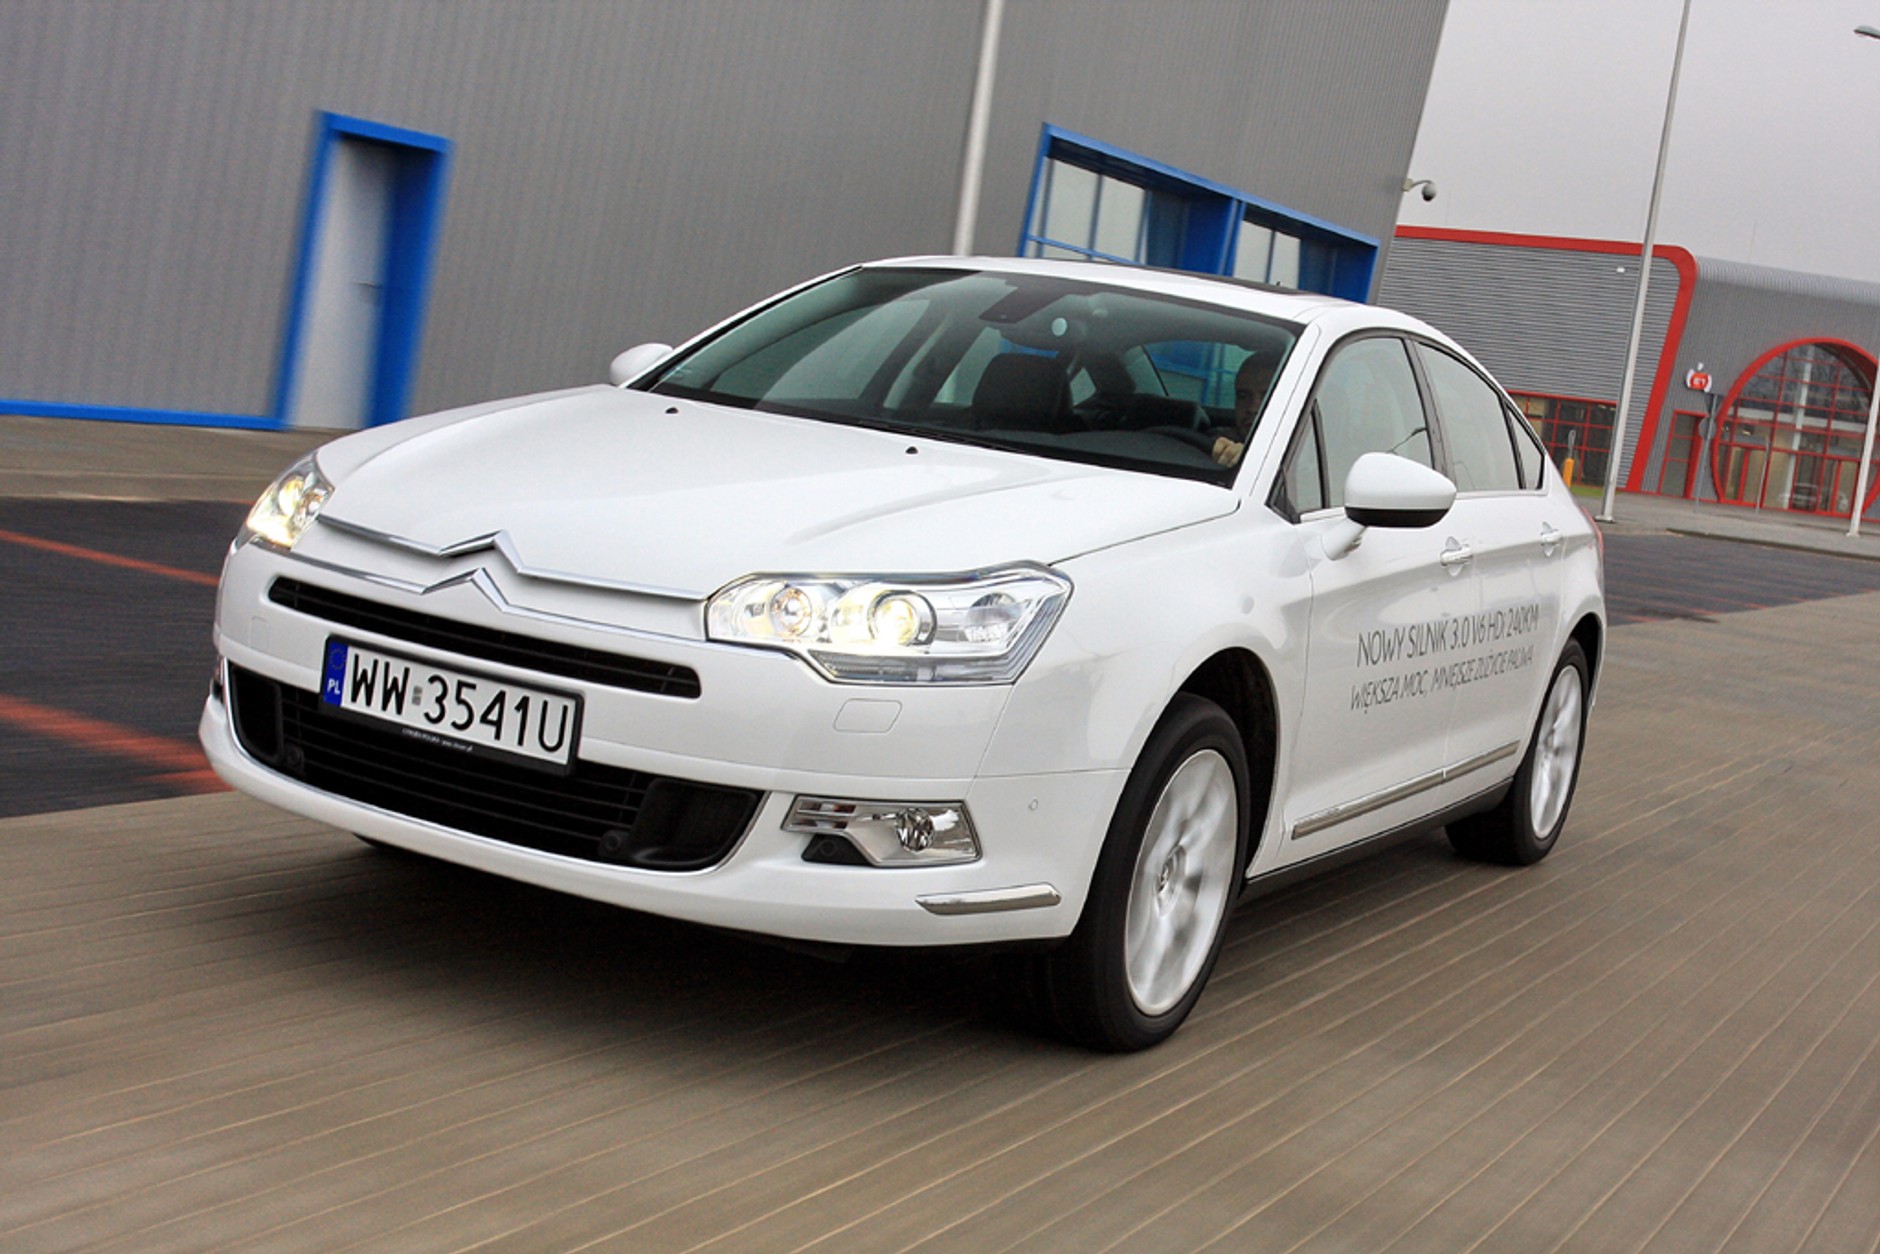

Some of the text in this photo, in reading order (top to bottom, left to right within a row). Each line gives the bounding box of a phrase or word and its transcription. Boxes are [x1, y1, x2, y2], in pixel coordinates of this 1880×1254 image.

[1356, 626, 1406, 668] NOWY
[1407, 620, 1448, 658] SILNIK
[1450, 617, 1470, 650] 3.0
[1471, 614, 1486, 645] V6
[327, 678, 341, 695] PL
[350, 653, 569, 753] WW 3541U
[1350, 676, 1400, 714] WIĘKSZA
